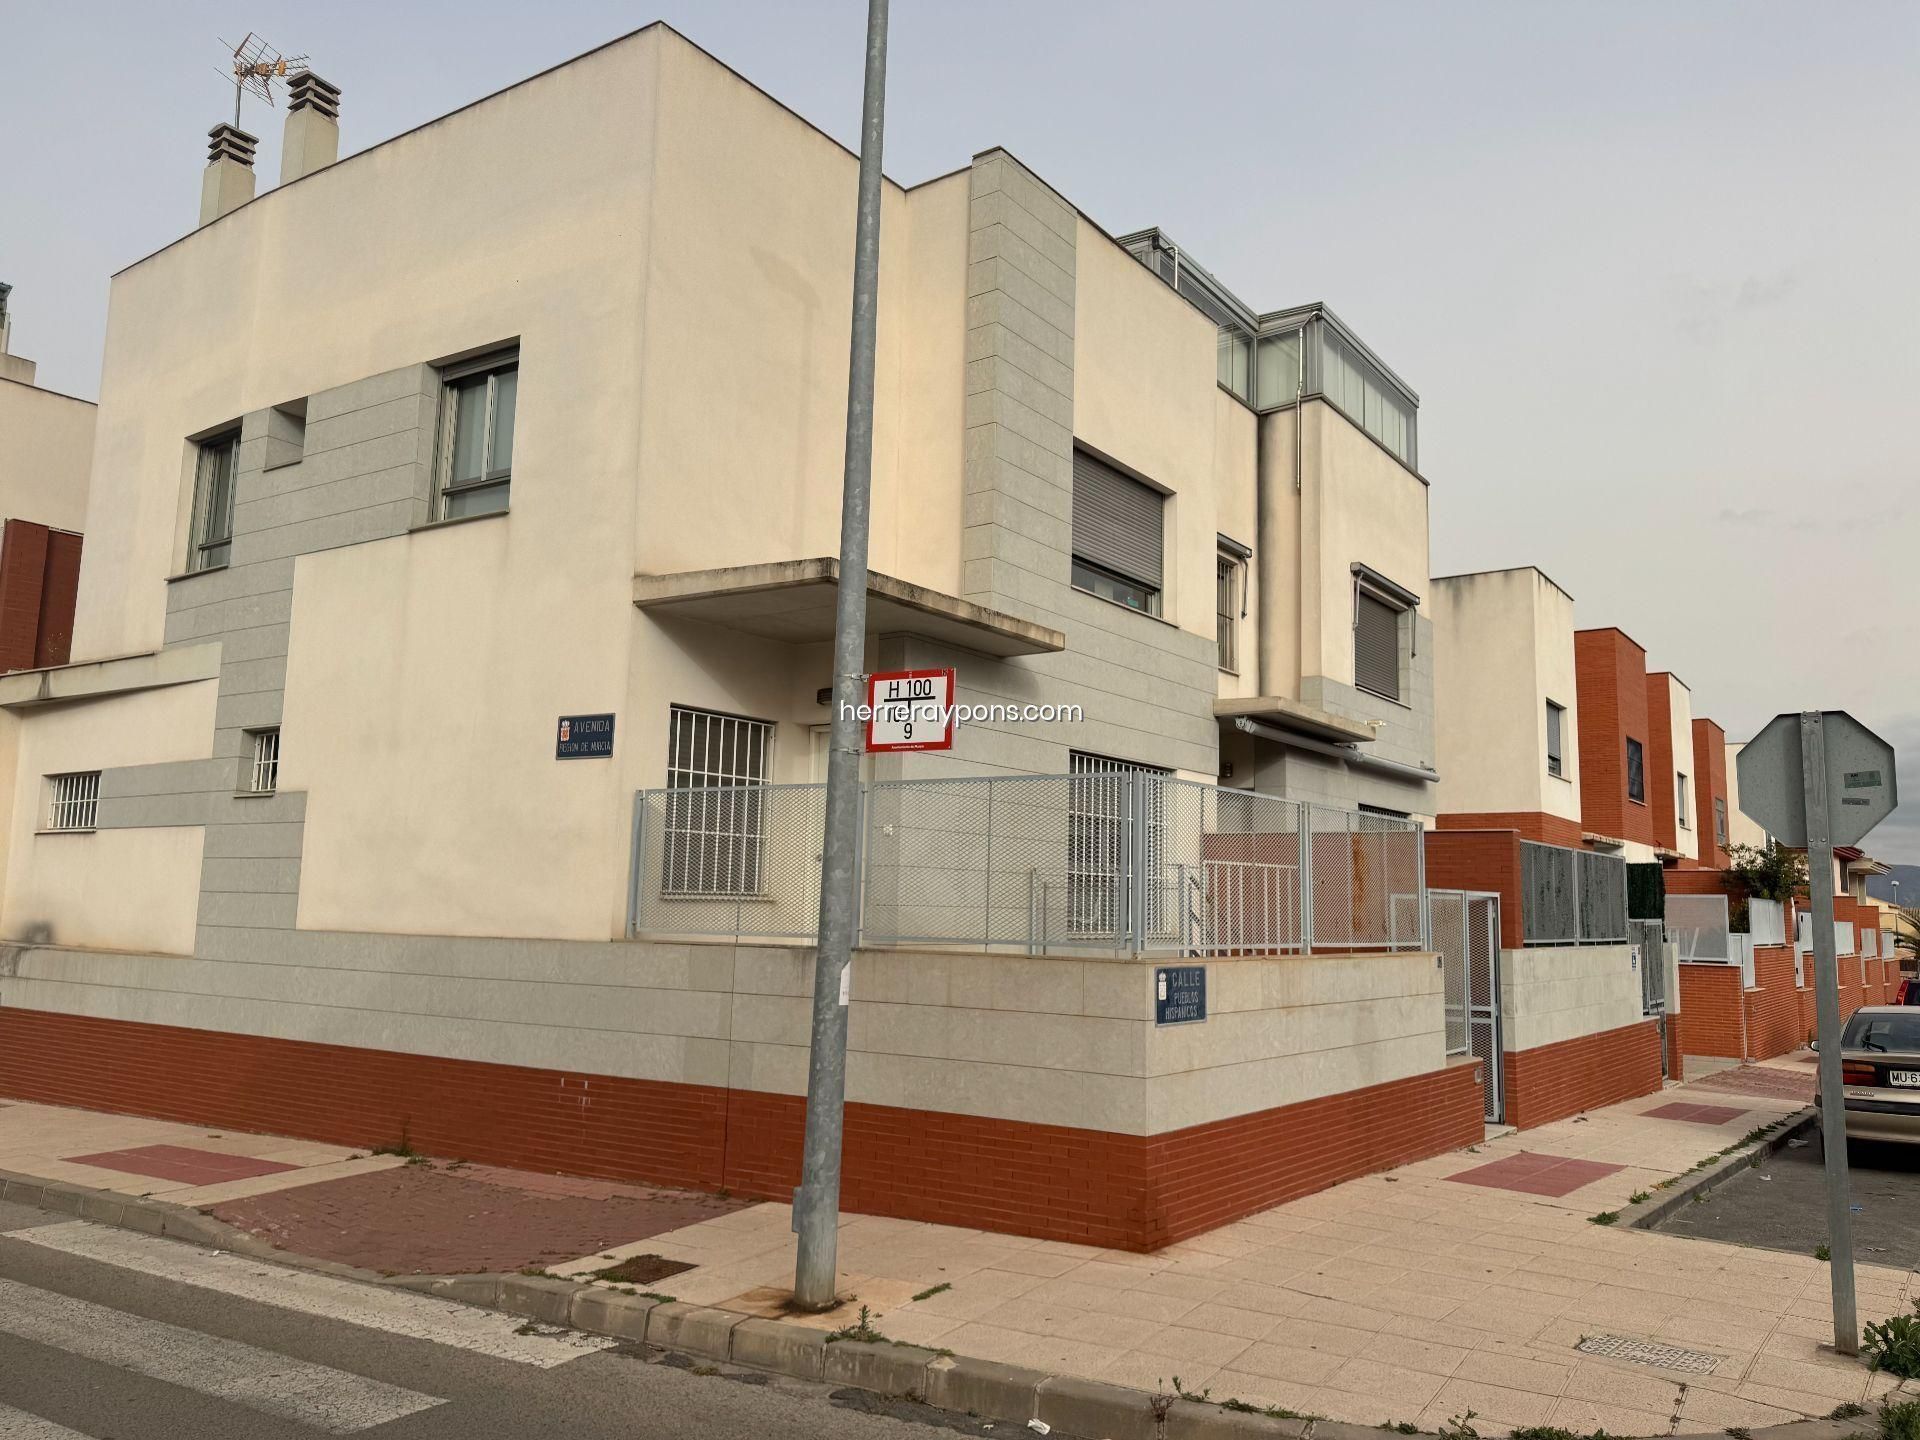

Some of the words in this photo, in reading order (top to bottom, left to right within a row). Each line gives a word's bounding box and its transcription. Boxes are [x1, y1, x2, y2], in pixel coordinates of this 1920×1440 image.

[889, 680, 899, 698] H
[907, 678, 931, 697] 100
[573, 720, 610, 733] AVENIDA
[904, 722, 912, 740] 9
[1172, 971, 1200, 988] CALLE
